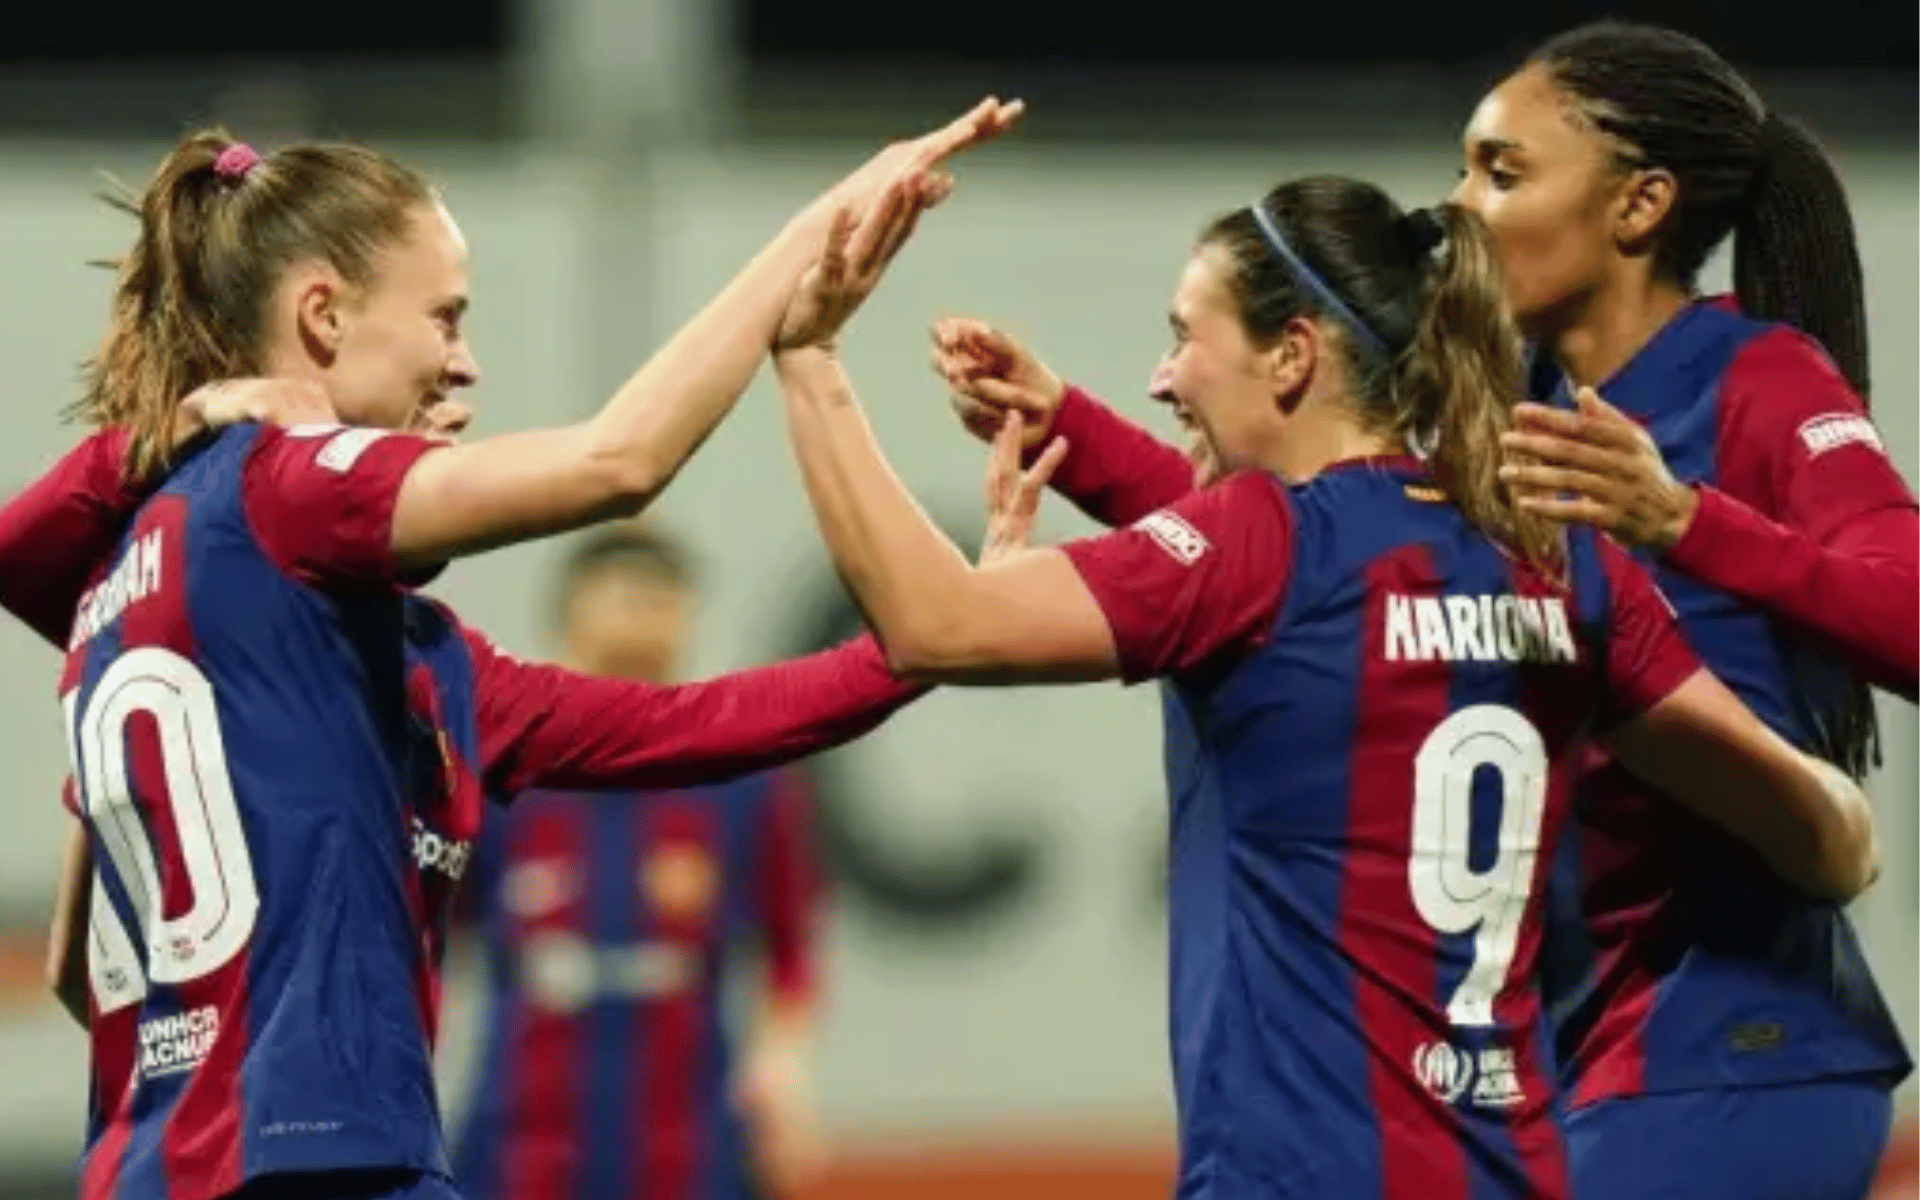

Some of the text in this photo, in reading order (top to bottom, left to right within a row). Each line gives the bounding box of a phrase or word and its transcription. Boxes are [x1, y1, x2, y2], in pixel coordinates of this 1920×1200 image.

[1384, 594, 1577, 662] MARIONA
[1408, 704, 1548, 1025] 9
[138, 1004, 219, 1045] UNHCR
